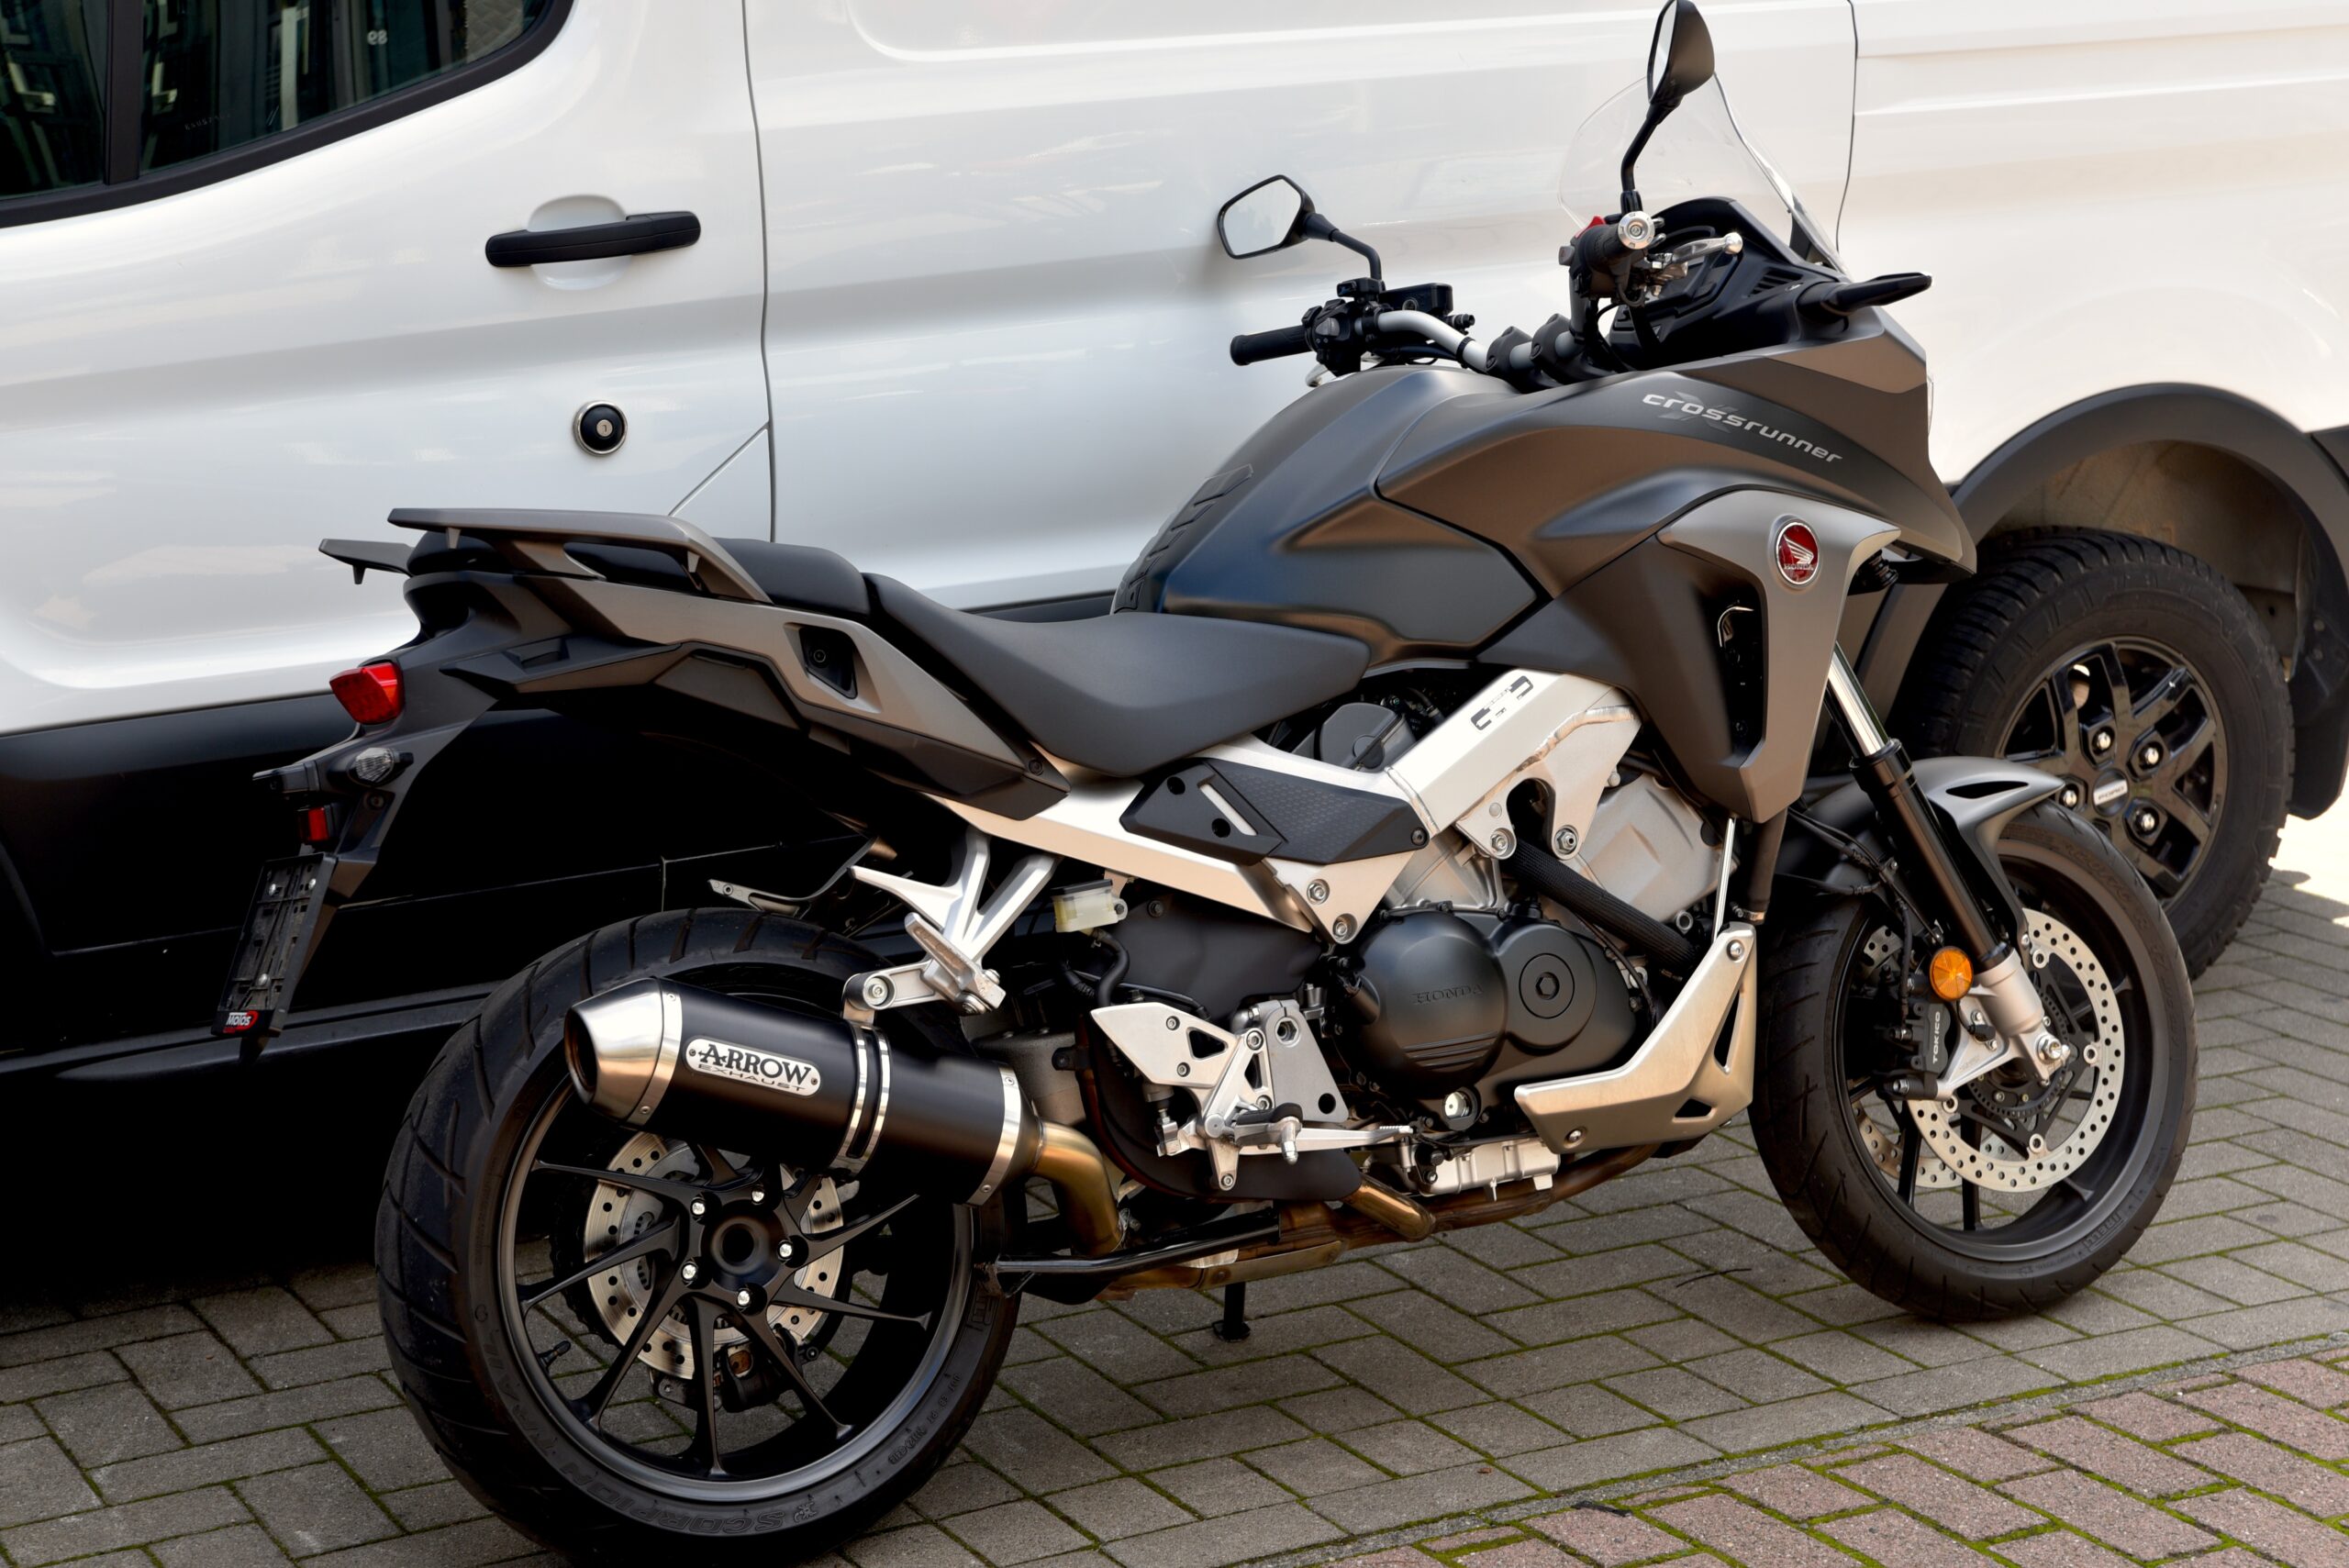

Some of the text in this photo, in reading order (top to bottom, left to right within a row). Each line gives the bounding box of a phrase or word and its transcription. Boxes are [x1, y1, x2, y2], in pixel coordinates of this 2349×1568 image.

[1642, 394, 1842, 462] crossrunner
[1411, 984, 1484, 1006] HONDA
[1932, 1011, 1941, 1064] TOKICO
[698, 1043, 811, 1085] ARROW
[698, 1063, 806, 1092] EXHAUST
[560, 1461, 785, 1534] SCORPION
